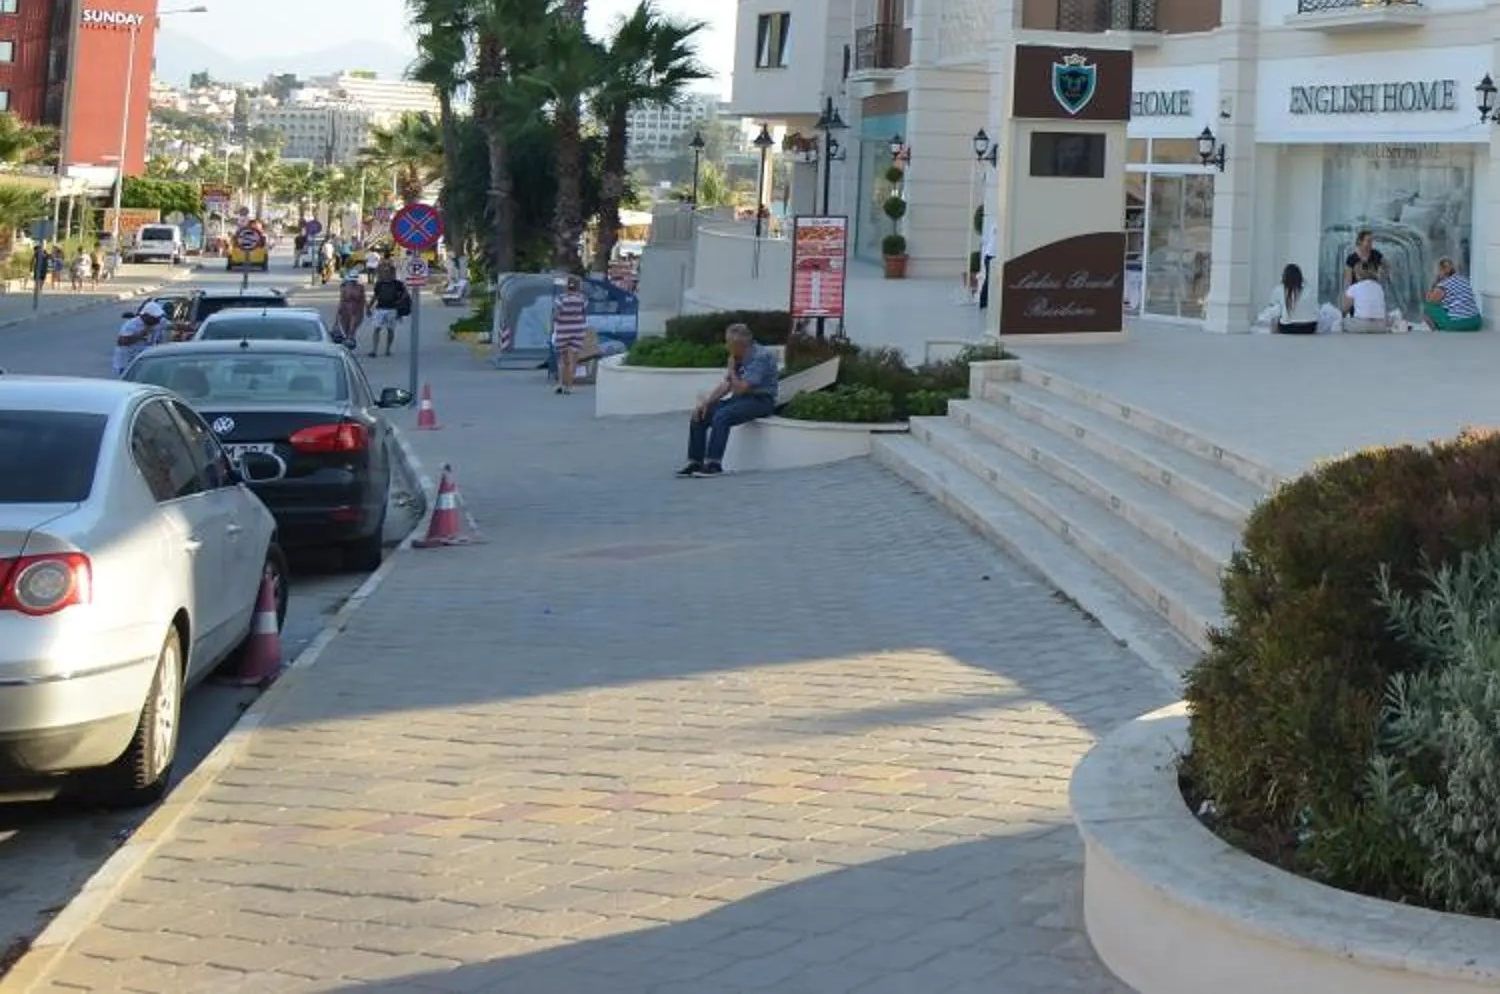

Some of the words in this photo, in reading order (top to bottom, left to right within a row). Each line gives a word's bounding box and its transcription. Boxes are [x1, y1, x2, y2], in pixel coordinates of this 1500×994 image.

[82, 9, 144, 25] SUNDAY
[1132, 89, 1193, 116] HOME
[1289, 83, 1376, 114] ENGLISH
[1381, 79, 1458, 112] HOME
